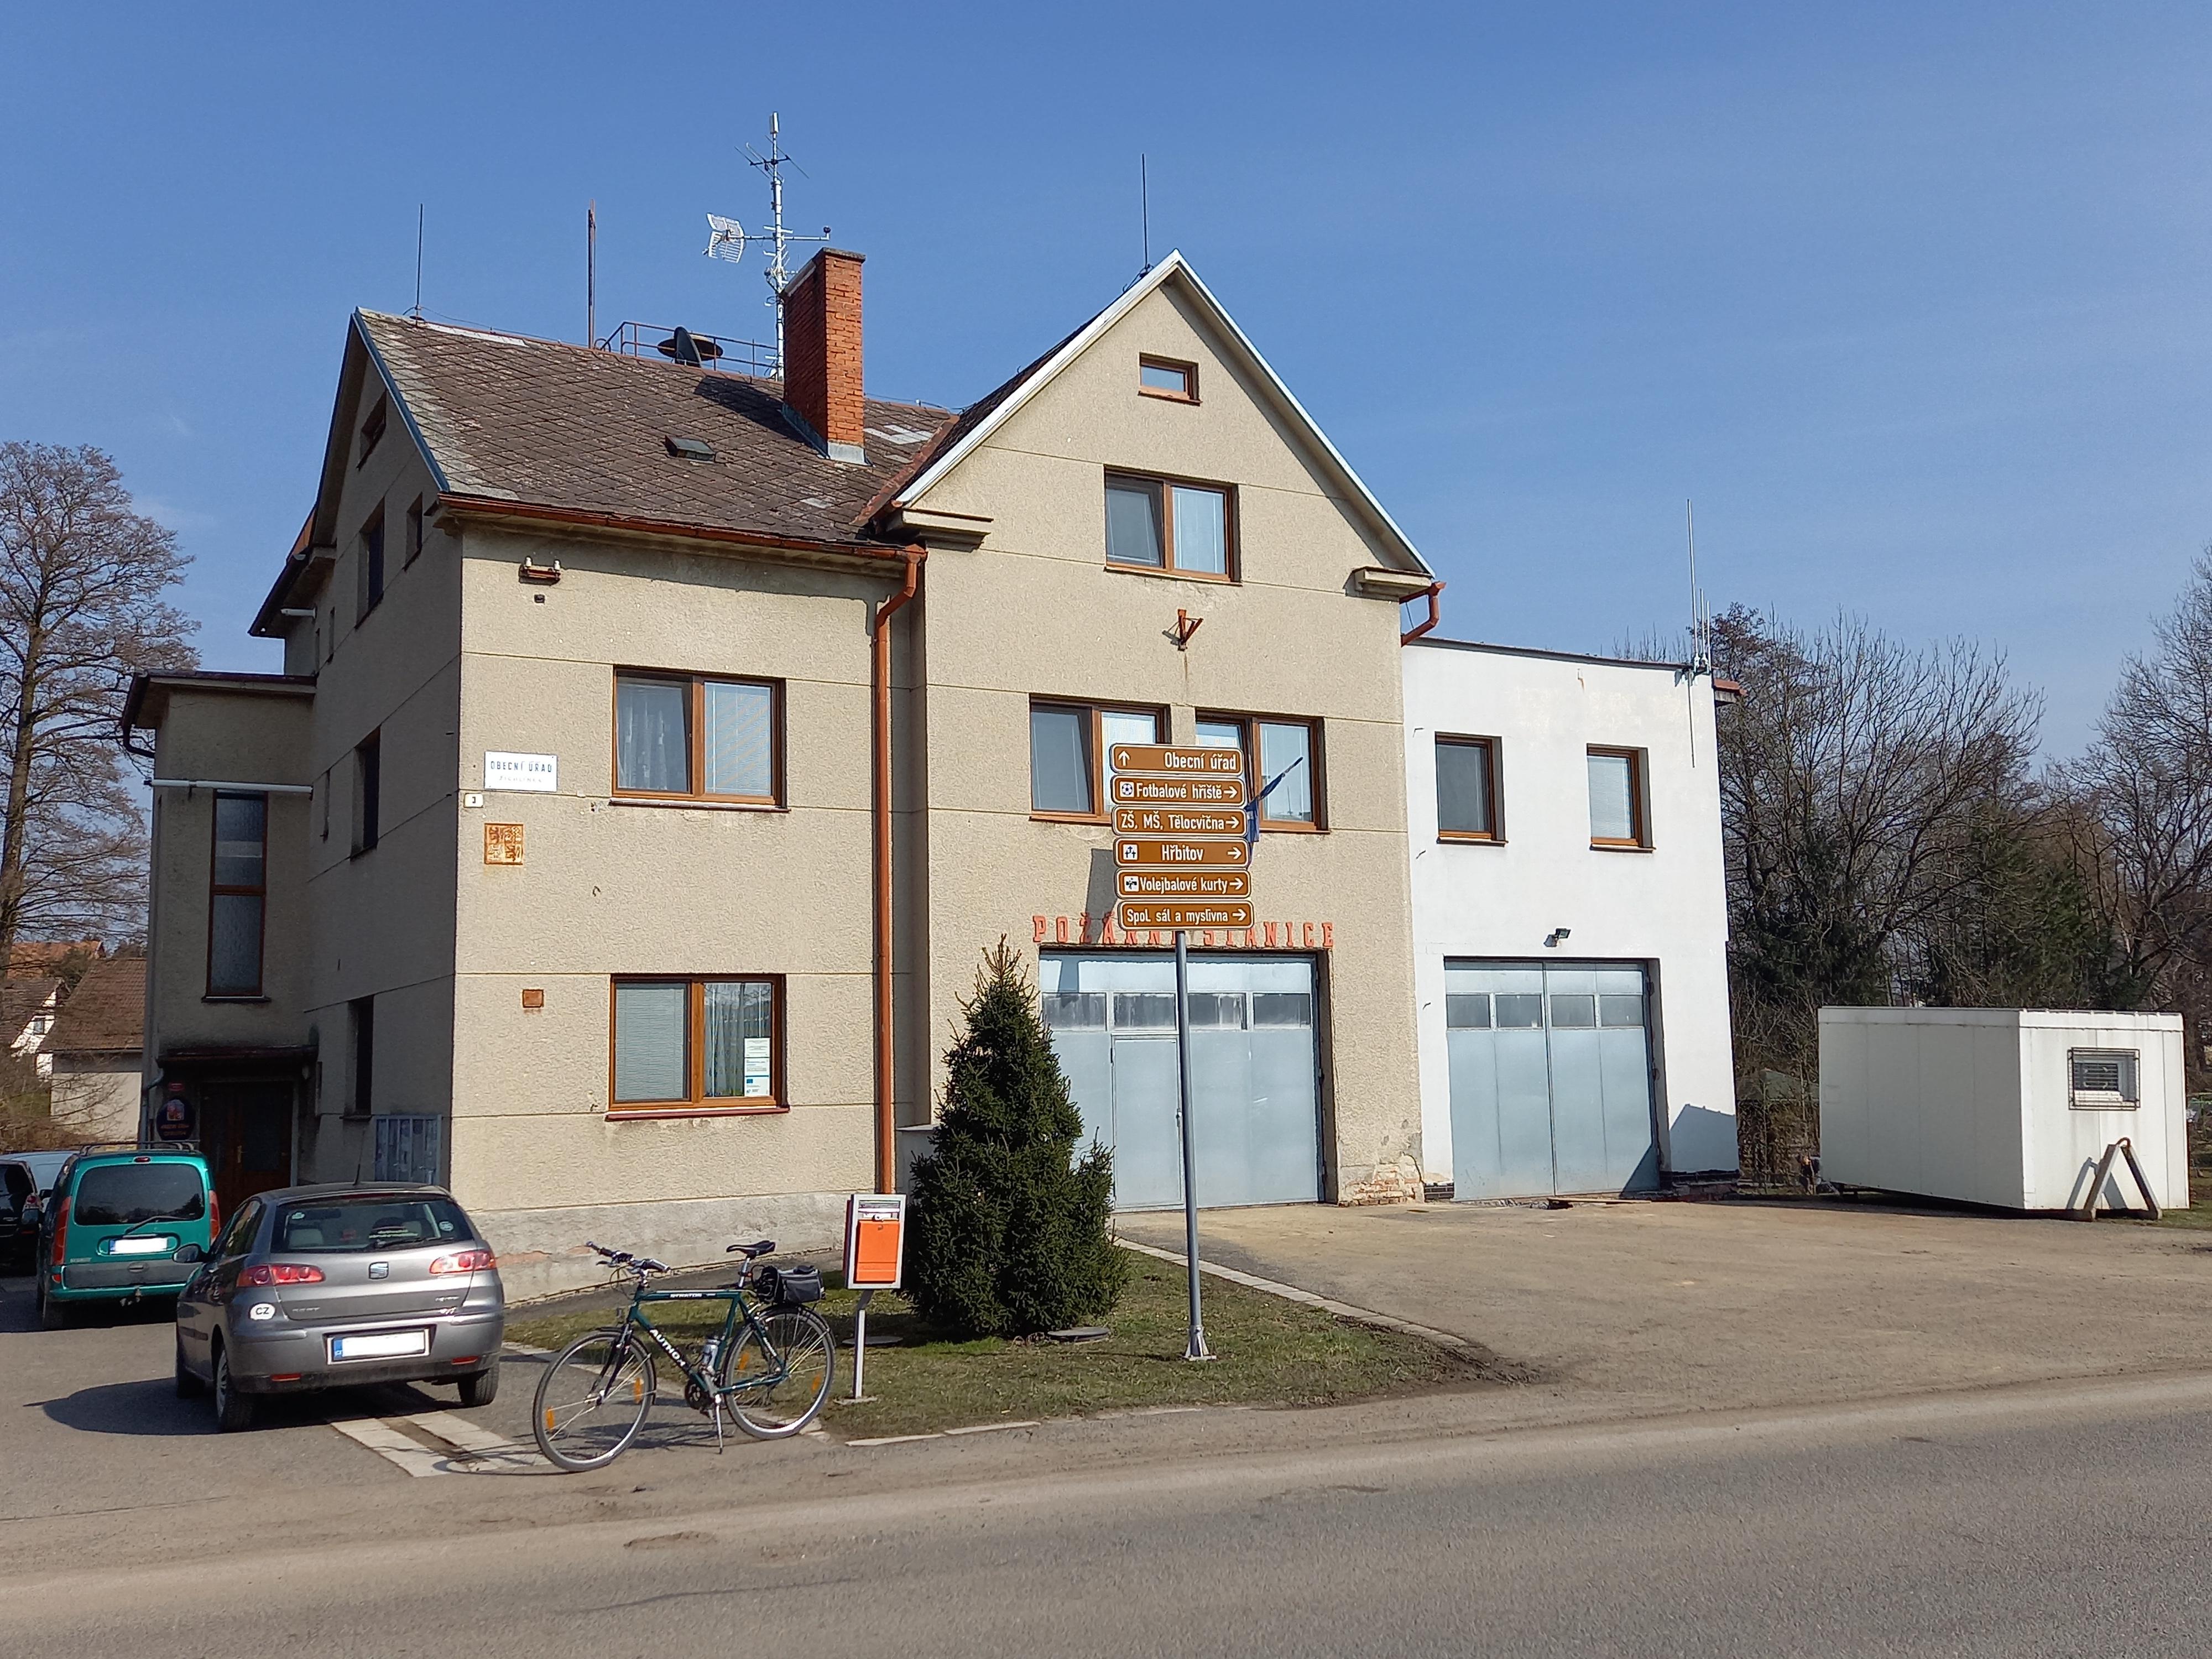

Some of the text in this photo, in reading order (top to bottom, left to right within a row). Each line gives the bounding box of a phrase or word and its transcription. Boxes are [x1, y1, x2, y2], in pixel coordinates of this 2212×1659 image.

[490, 760, 552, 773] OBECNÍ ÚŘAD
[1164, 752, 1237, 770] Obecní úřad
[1136, 782, 1223, 800] Fotbalové hřiště
[1121, 810, 1224, 830] ZŠ, MŠ, Tělocvična
[1161, 844, 1204, 861] Hřbitov
[1139, 877, 1228, 894] Volejbalové kurty
[1126, 909, 1228, 925] Spol. sál a myslivna
[1032, 911, 1176, 945] POŽÁRN
[255, 1307, 270, 1315] CZ
